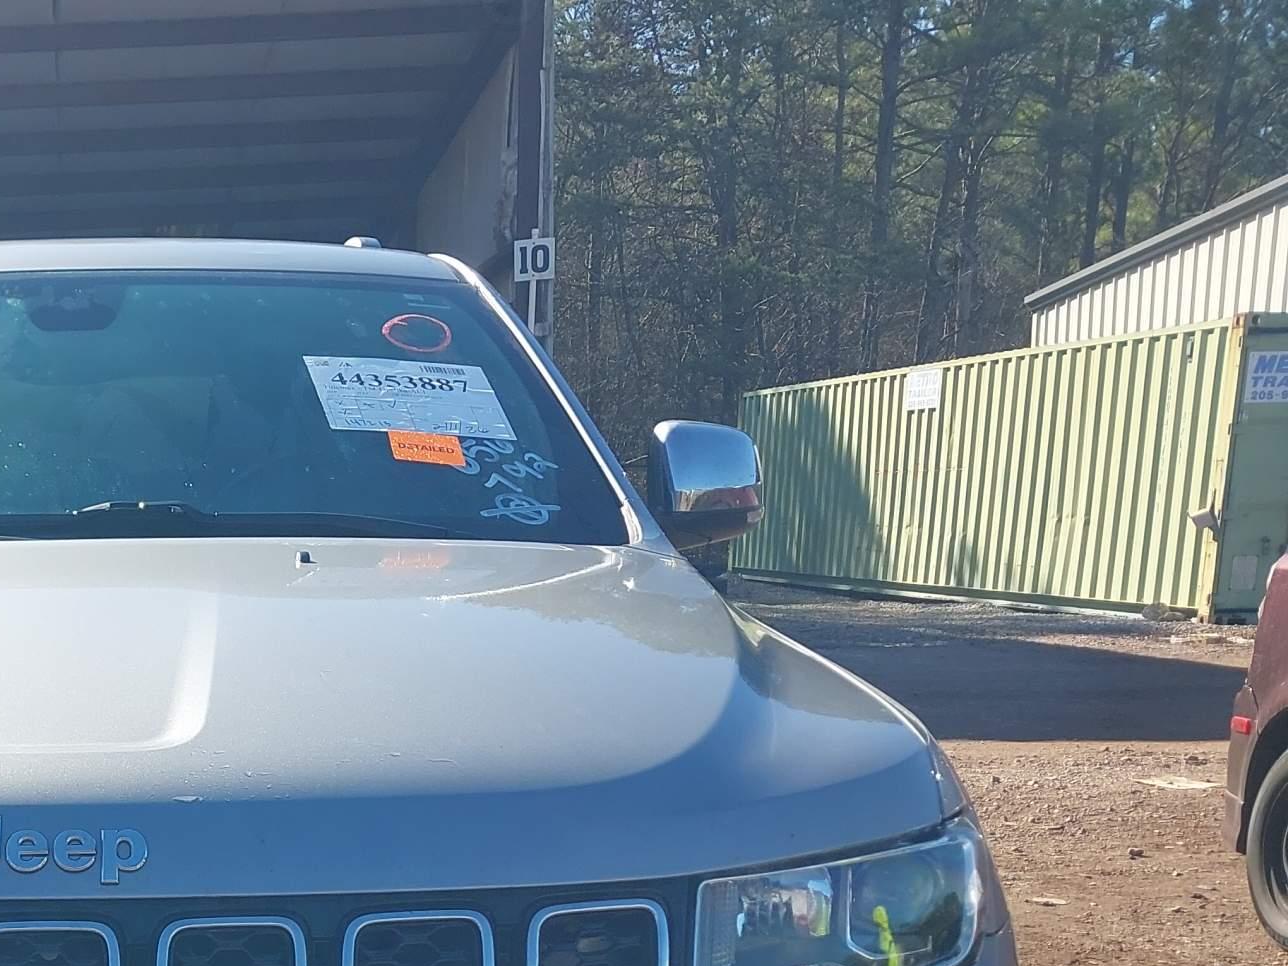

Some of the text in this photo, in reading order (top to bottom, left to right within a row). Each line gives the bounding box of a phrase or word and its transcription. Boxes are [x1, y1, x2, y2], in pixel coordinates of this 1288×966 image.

[519, 244, 550, 275] 10
[1253, 354, 1288, 374] ME
[331, 371, 468, 393] 44353887
[1251, 375, 1288, 388] TRA
[397, 442, 455, 455] DETAILED
